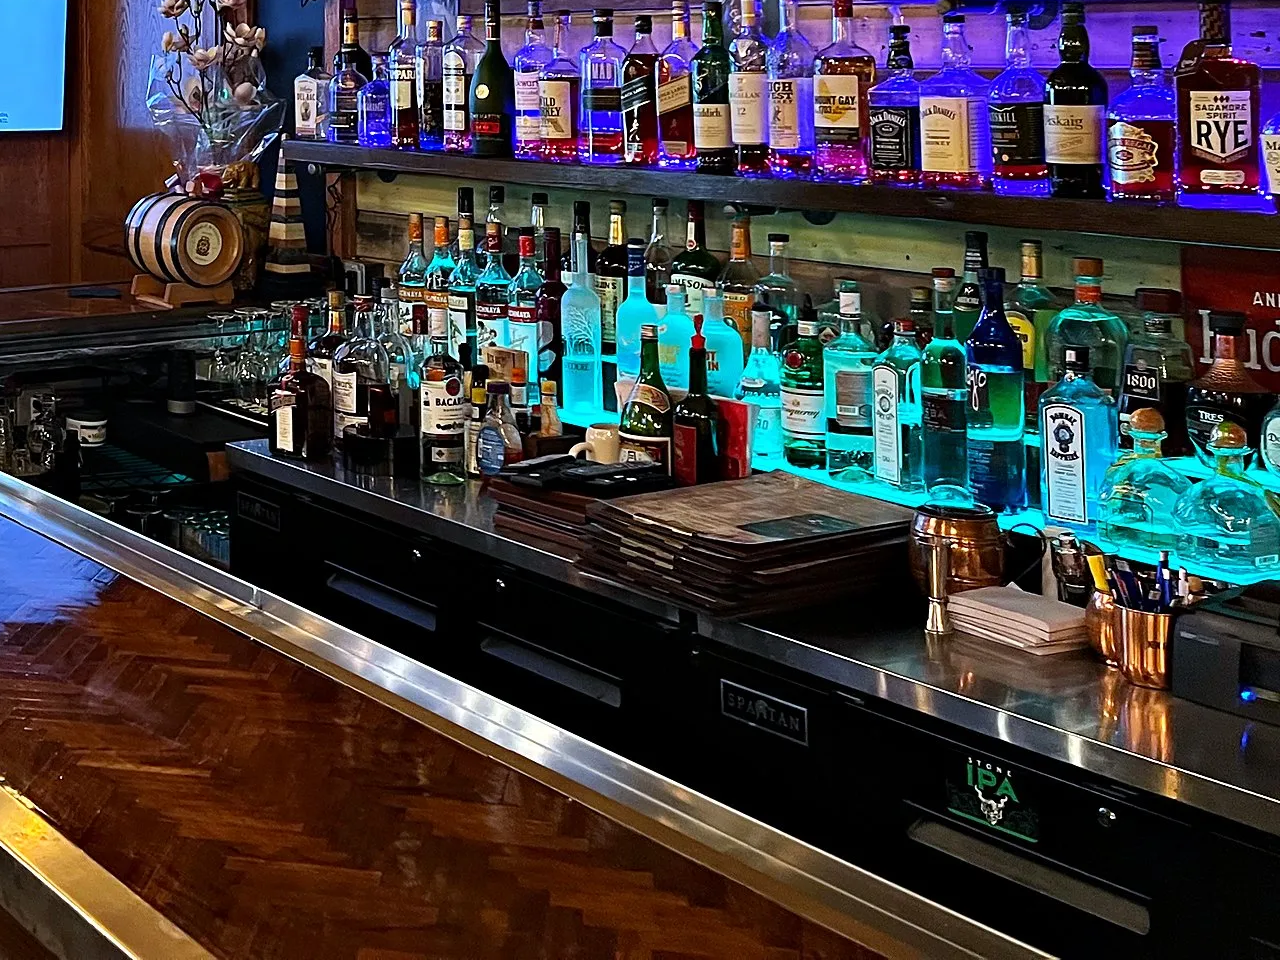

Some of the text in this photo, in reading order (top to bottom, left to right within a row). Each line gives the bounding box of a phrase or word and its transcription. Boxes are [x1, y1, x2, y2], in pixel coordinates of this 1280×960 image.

[767, 81, 793, 92] IGH
[1194, 103, 1247, 111] SAGAMORE
[1196, 120, 1248, 154] RYE
[1126, 373, 1156, 390] 1800
[1198, 409, 1224, 422] TRES
[728, 692, 800, 732] SPARTAN
[967, 756, 1012, 778] STONE
[966, 763, 1020, 804] IPA
